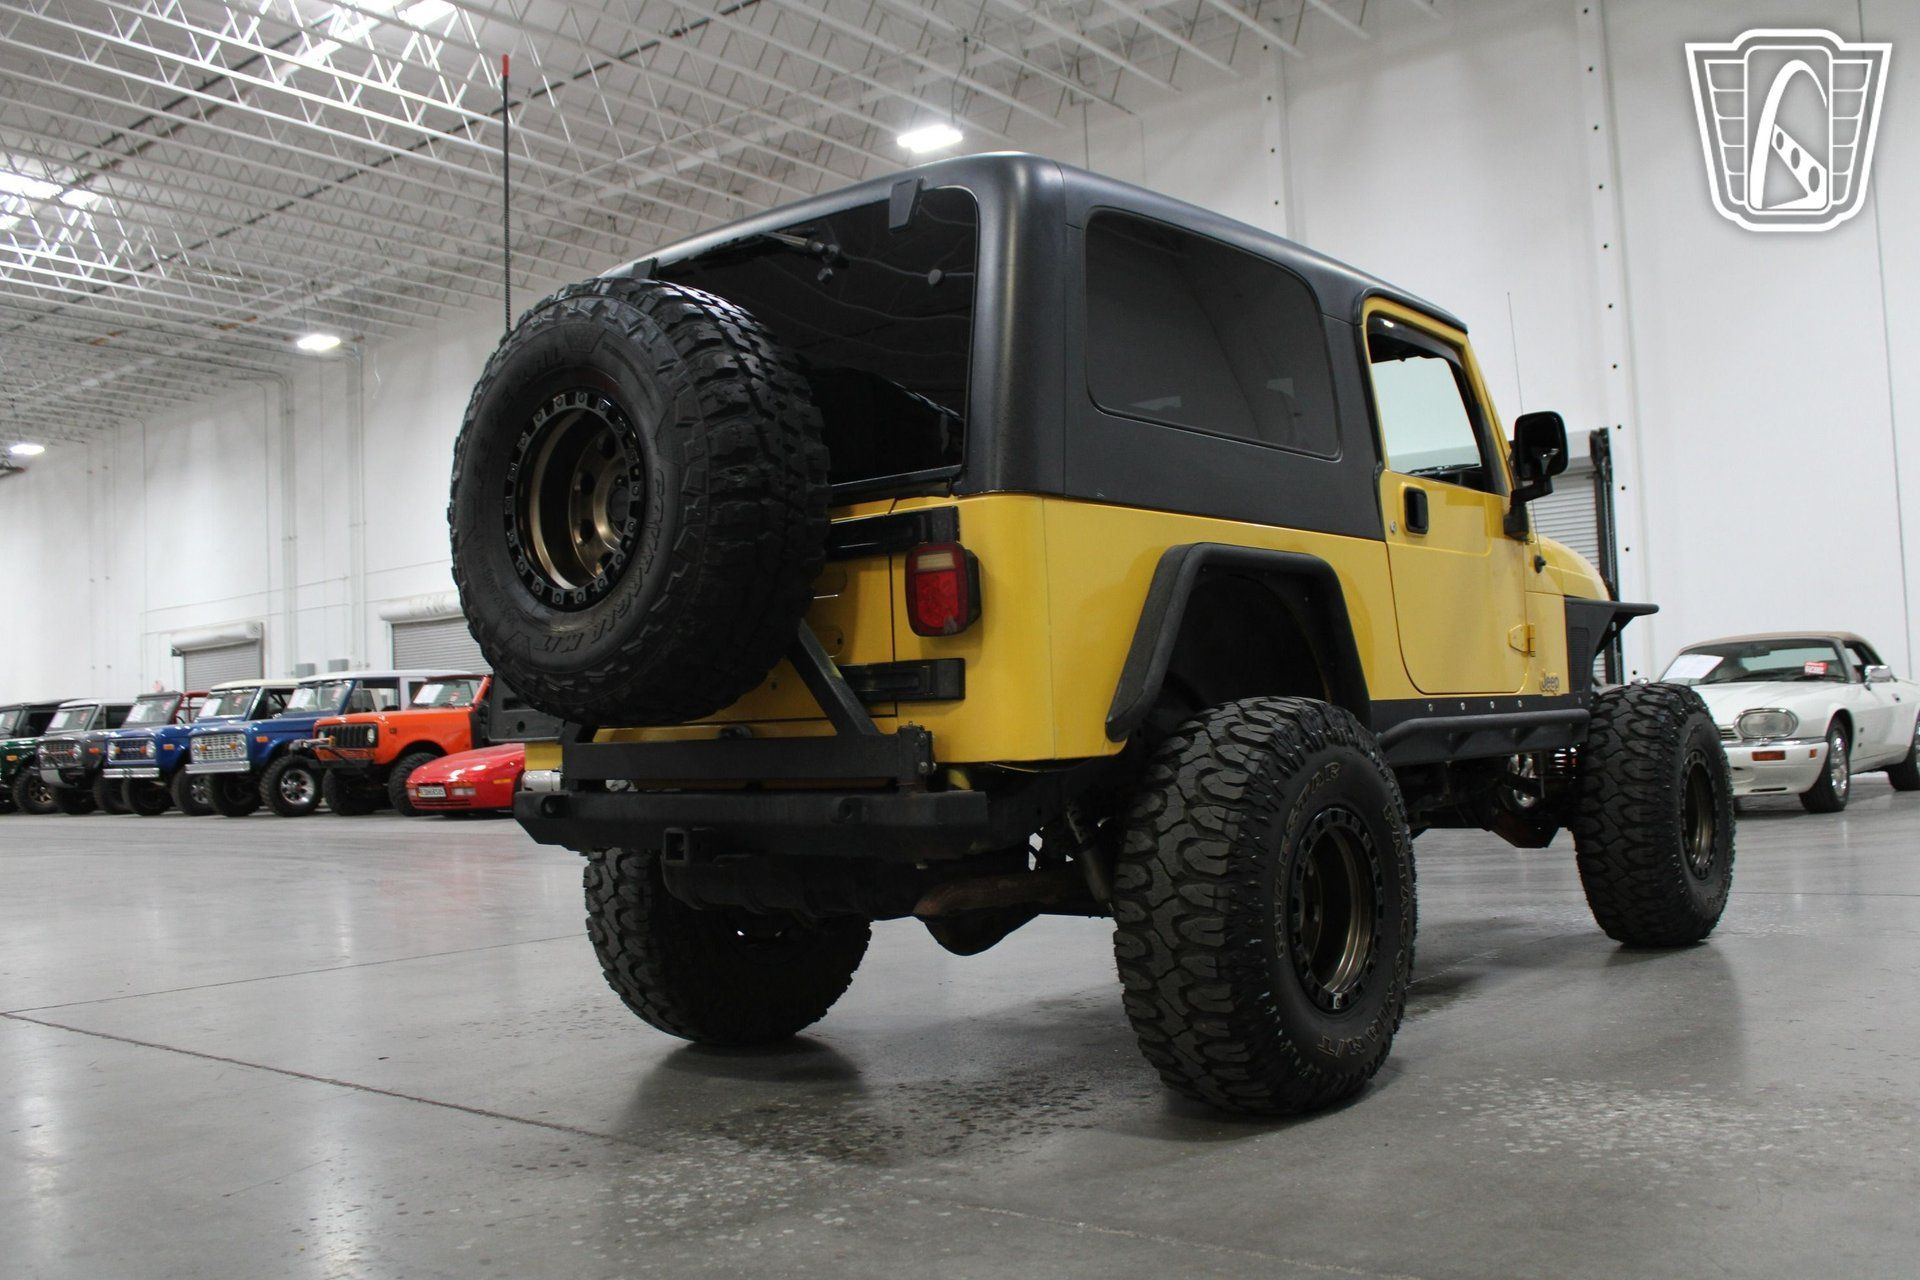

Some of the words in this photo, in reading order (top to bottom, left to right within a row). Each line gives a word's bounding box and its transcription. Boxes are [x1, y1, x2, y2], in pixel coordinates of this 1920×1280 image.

[1541, 671, 1560, 694] Jeep
[1366, 802, 1411, 1042] PATAGONIA
[1316, 1031, 1366, 1059] M/T
